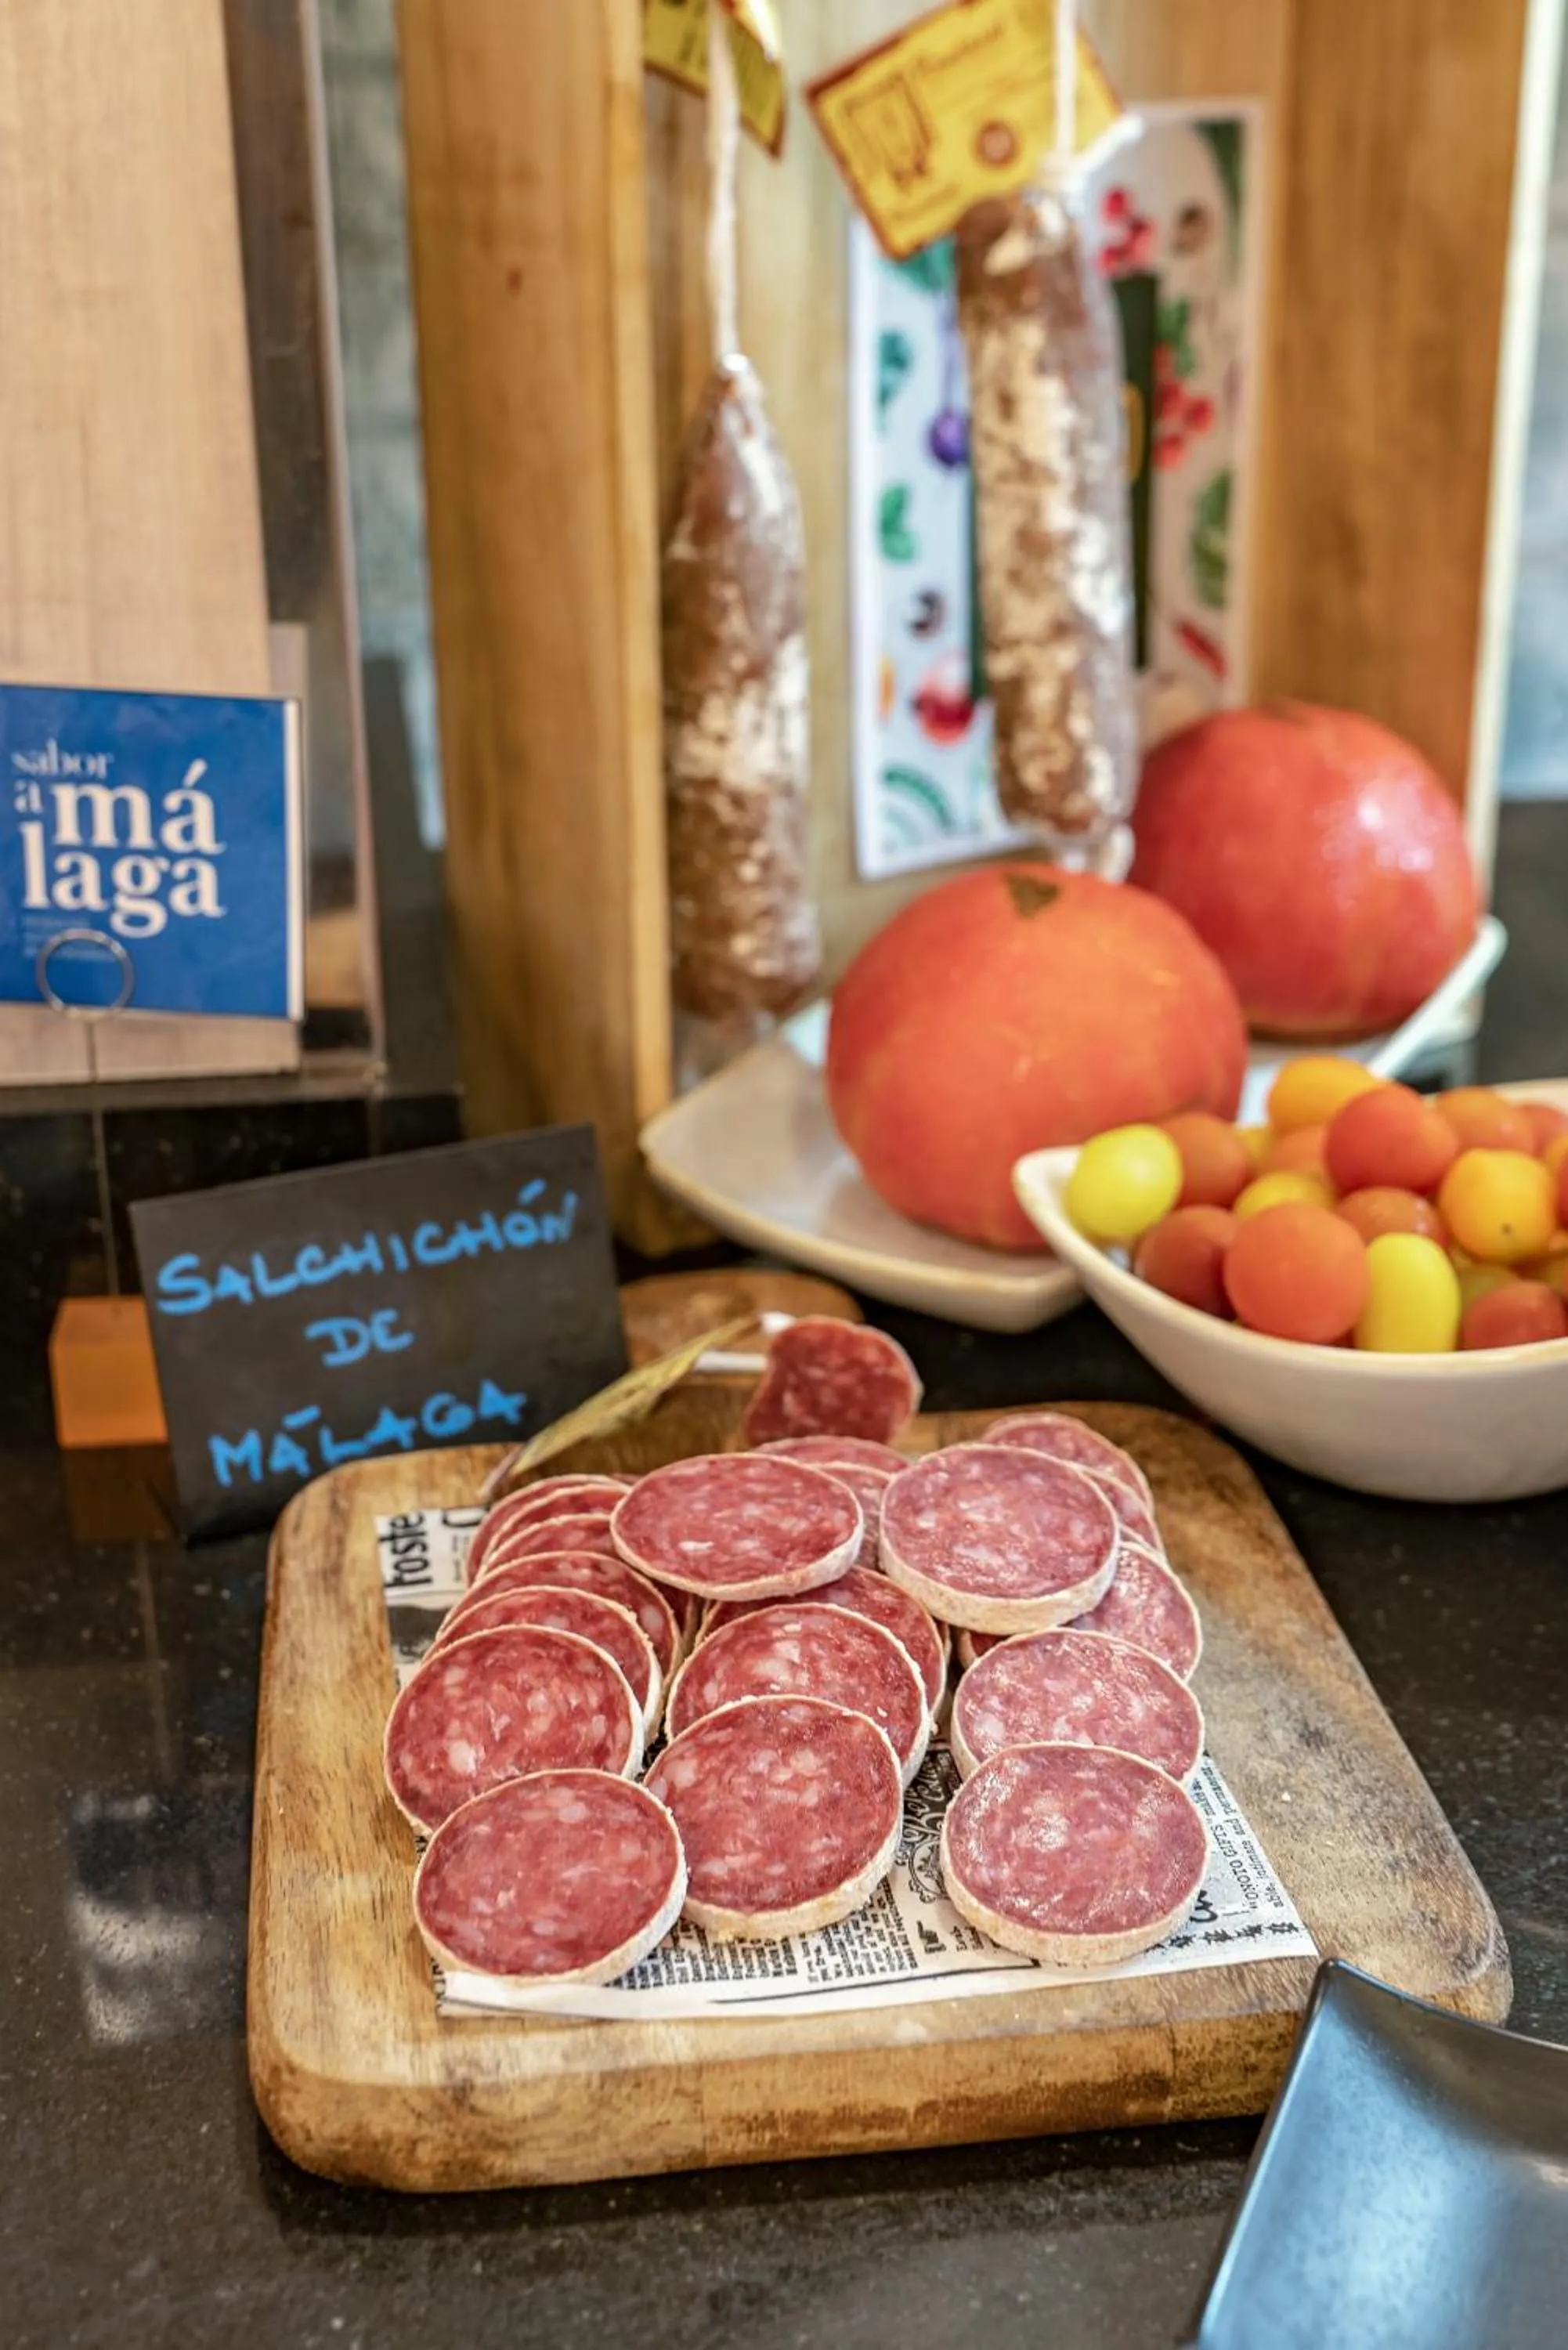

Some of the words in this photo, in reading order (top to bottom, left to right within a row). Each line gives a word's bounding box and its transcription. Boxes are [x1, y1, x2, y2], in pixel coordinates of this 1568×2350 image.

[11, 739, 114, 778] sabor
[14, 780, 44, 813] a
[52, 758, 227, 855] má
[20, 820, 227, 938] laga
[157, 1178, 578, 1315] SALCHICHÓN
[305, 1309, 414, 1367] DE
[208, 1379, 527, 1487] MÁLAGA
